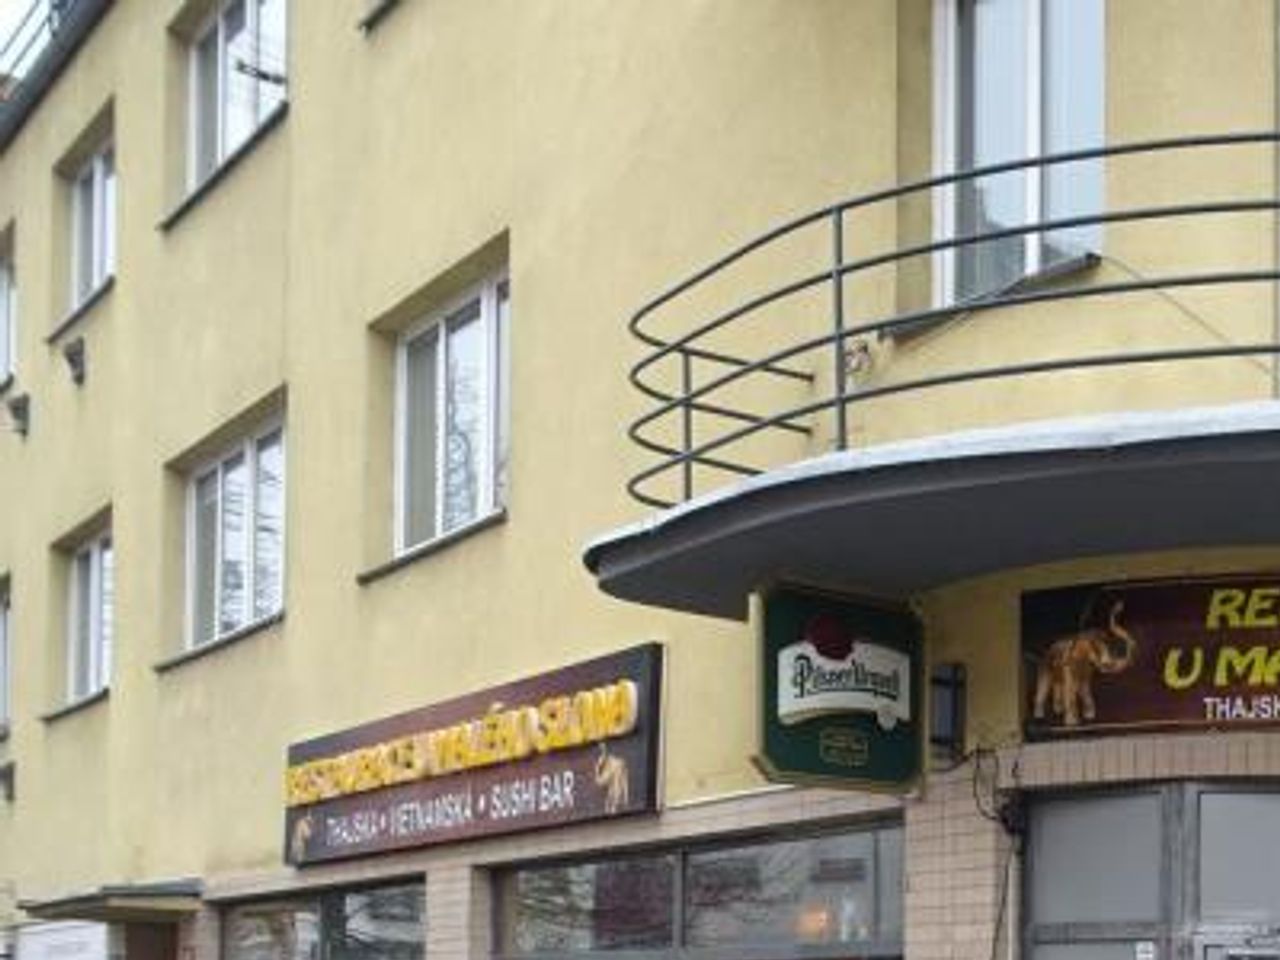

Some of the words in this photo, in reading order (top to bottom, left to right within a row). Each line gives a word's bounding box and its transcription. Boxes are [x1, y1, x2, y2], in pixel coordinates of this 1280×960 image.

[1164, 647, 1203, 690] U
[490, 780, 536, 820] SUSHI
[539, 770, 575, 811] BAR
